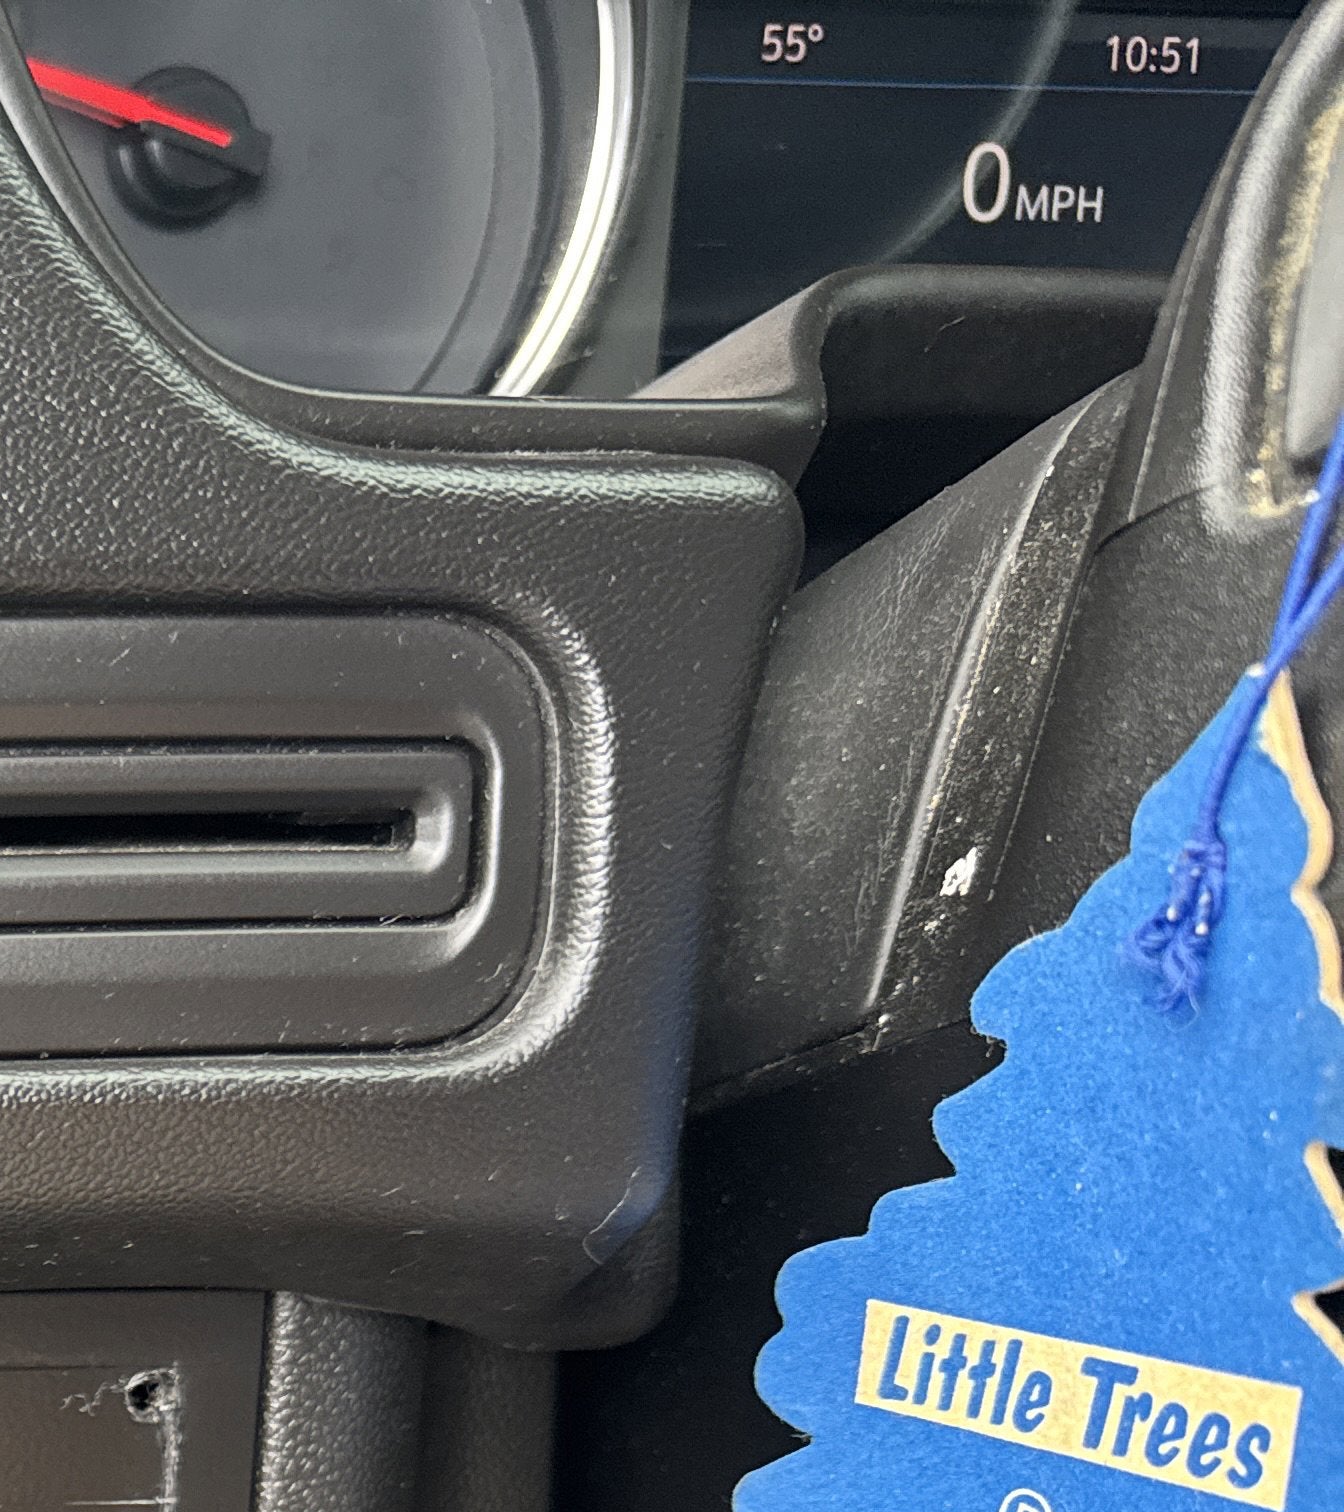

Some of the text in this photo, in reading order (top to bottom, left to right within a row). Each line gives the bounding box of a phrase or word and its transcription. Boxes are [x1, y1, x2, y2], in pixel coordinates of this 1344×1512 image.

[760, 22, 825, 64] 55°
[1106, 35, 1201, 76] 10:51
[963, 142, 1104, 224] 0 MPH
[877, 1314, 1272, 1489] Little Trees
